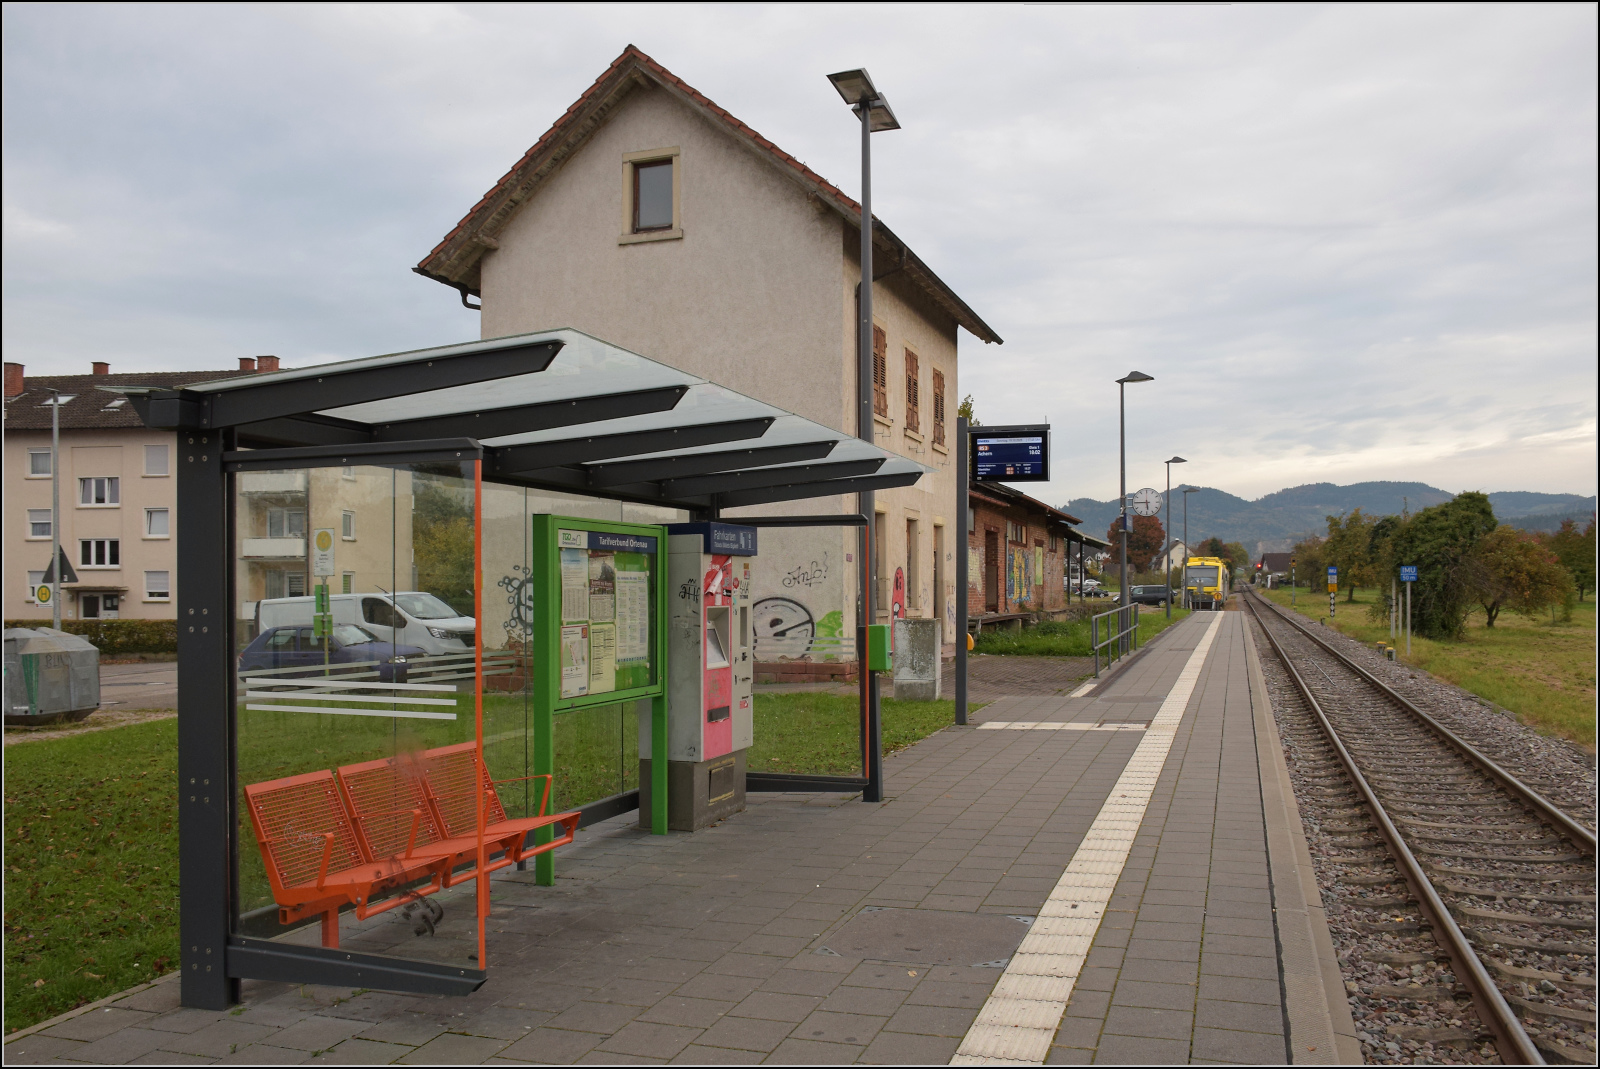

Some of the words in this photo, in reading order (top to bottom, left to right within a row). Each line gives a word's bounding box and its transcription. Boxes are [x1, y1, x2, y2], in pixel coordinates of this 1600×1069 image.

[714, 530, 737, 541] Fahrkarten
[599, 536, 628, 546] Tarifverbund
[630, 540, 648, 548] Ortenau
